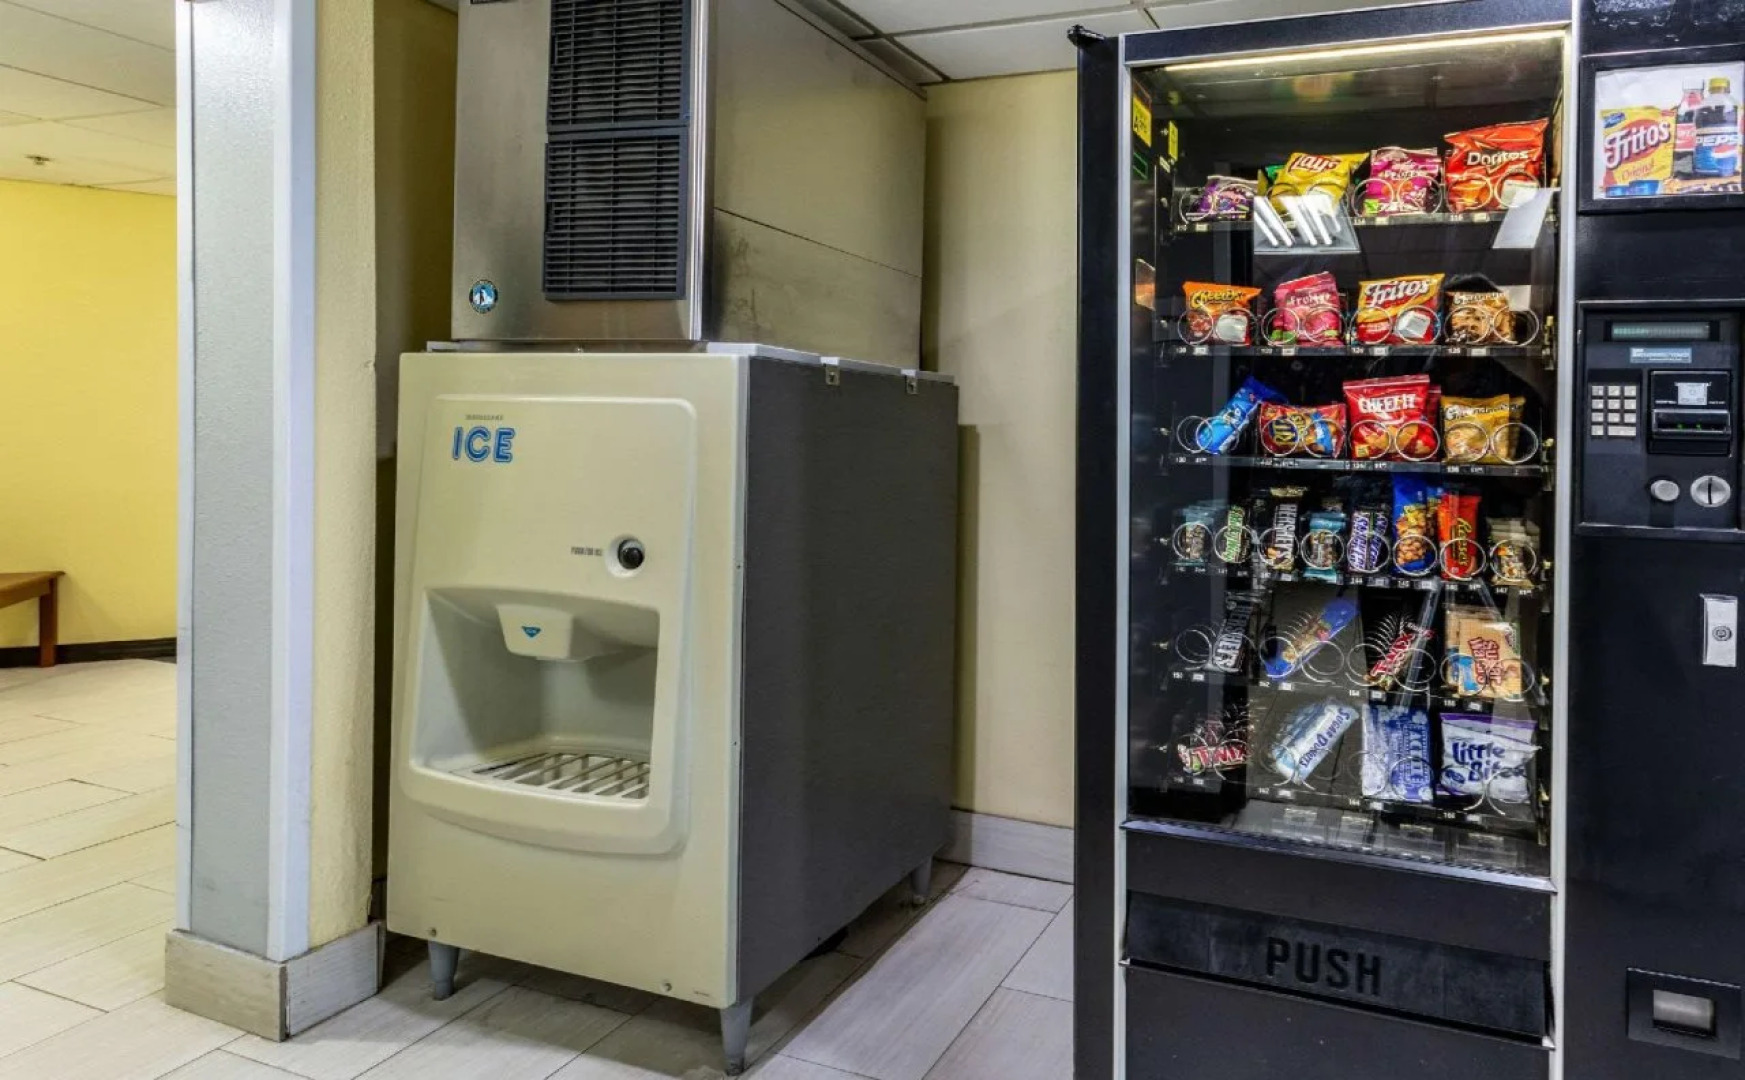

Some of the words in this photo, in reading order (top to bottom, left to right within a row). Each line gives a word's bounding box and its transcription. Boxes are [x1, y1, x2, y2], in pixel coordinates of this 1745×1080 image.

[1467, 151, 1529, 166] Doritos
[1603, 121, 1670, 169] Fritos
[1365, 278, 1431, 307] Fritos
[453, 425, 515, 462] ICE
[1456, 517, 1472, 566] Reese's
[1451, 741, 1506, 765] Little
[1266, 936, 1381, 996] PUSH
